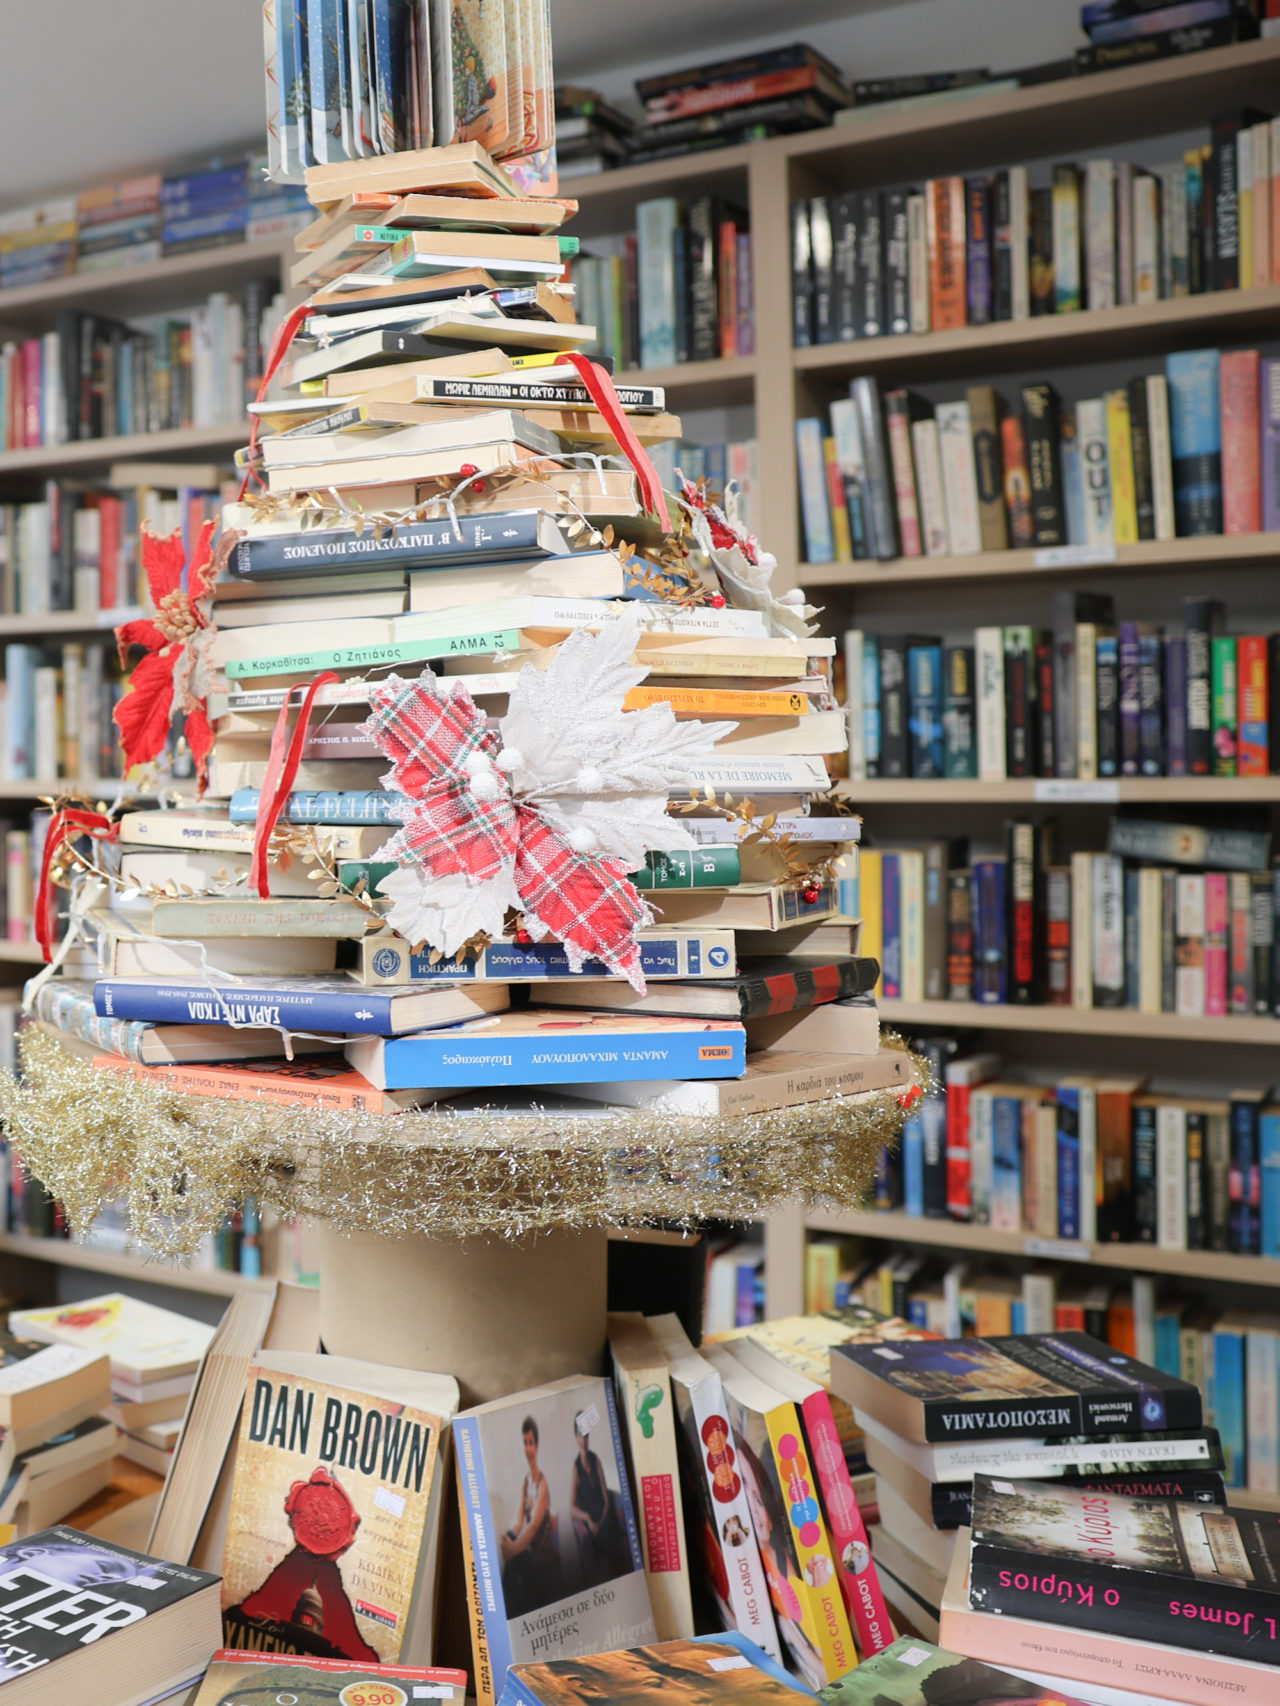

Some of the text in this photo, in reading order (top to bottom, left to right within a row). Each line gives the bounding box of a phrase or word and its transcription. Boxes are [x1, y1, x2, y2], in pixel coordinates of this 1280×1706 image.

[445, 382, 470, 394] ΜΩΡΙΣ
[471, 384, 511, 397] ΛΕΜΠΛΑΝ
[519, 386, 529, 398] ΟΙ
[530, 387, 554, 399] ΟΚΤΩ
[283, 542, 347, 560] ΠΟΛΕΜΟΣ
[346, 647, 402, 663] Ζητιάνος
[449, 637, 487, 651] ΑΛΜΑ
[707, 770, 723, 780] LA
[724, 770, 740, 781] DE
[187, 1001, 220, 1021] ΓΚΩΛ
[248, 1004, 280, 1024] ΣΑΡΛ
[441, 1049, 669, 1068] ΑΜΑΝΤΑ ΜΙΧΑΛΟΠΟΥΛΟΥ Παλιόκαιρος
[796, 1075, 822, 1094] καρδιά
[824, 1075, 837, 1087] του
[941, 1407, 1071, 1431] ΜΕΣΟΠΟΤΑΜΙΑ
[249, 1378, 431, 1494] DAN BROWN
[351, 1573, 405, 1604] DA VINCI
[738, 1556, 761, 1627] MEG CABOT
[998, 1569, 1097, 1608] Κύριος
[520, 1588, 617, 1638] Ανάμεσα σε δύο
[856, 1578, 885, 1650] MEG CABOT
[1167, 1598, 1277, 1640] L James
[529, 1618, 580, 1657] μητέρες
[821, 1595, 847, 1669] MEG CABOT
[1112, 1658, 1125, 1669] Τα
[1132, 1662, 1194, 1685] ΛΑΛΑ-ΚΡΙΣΤ
[1195, 1673, 1248, 1694] ΔΕΣΠΟΙΝΑ
[352, 1693, 396, 1706] 9.90
